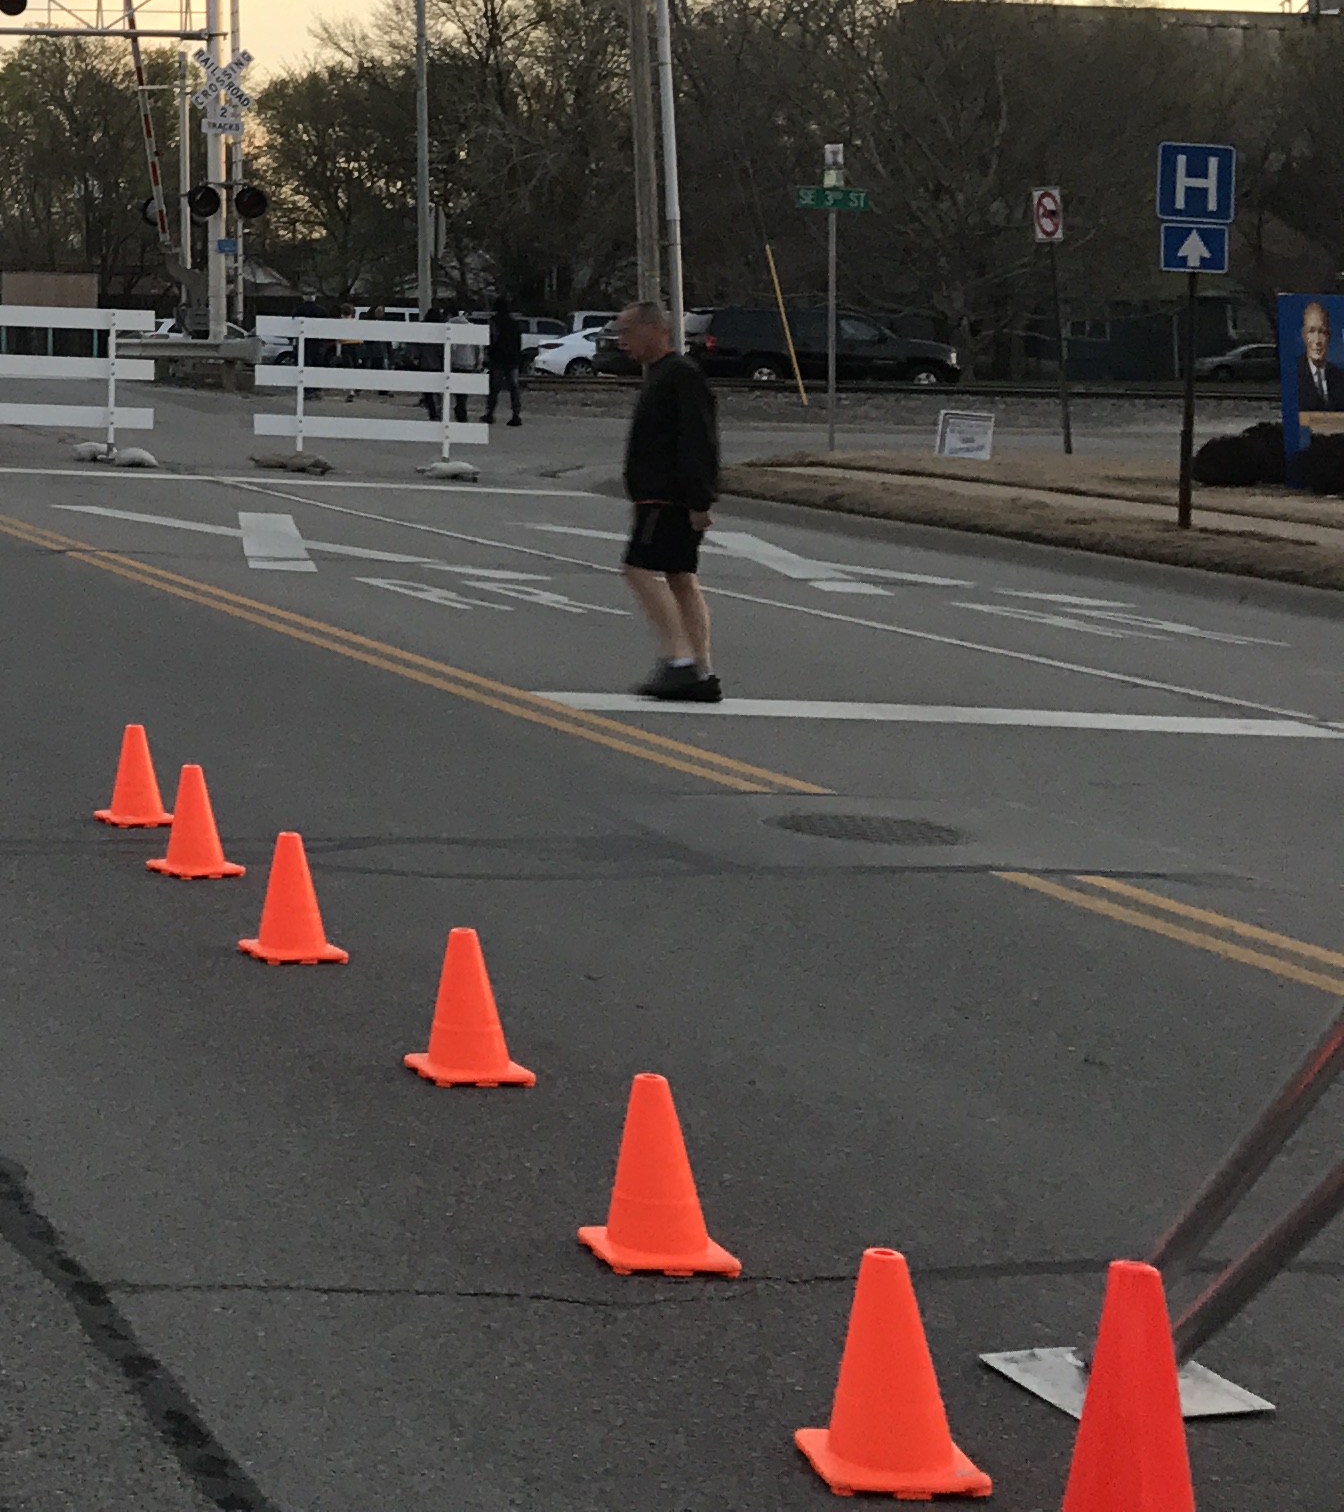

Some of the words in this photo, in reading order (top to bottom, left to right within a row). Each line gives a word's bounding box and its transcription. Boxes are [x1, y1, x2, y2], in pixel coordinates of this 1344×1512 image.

[219, 107, 228, 118] 2
[1174, 154, 1220, 212] H
[849, 192, 866, 208] ST
